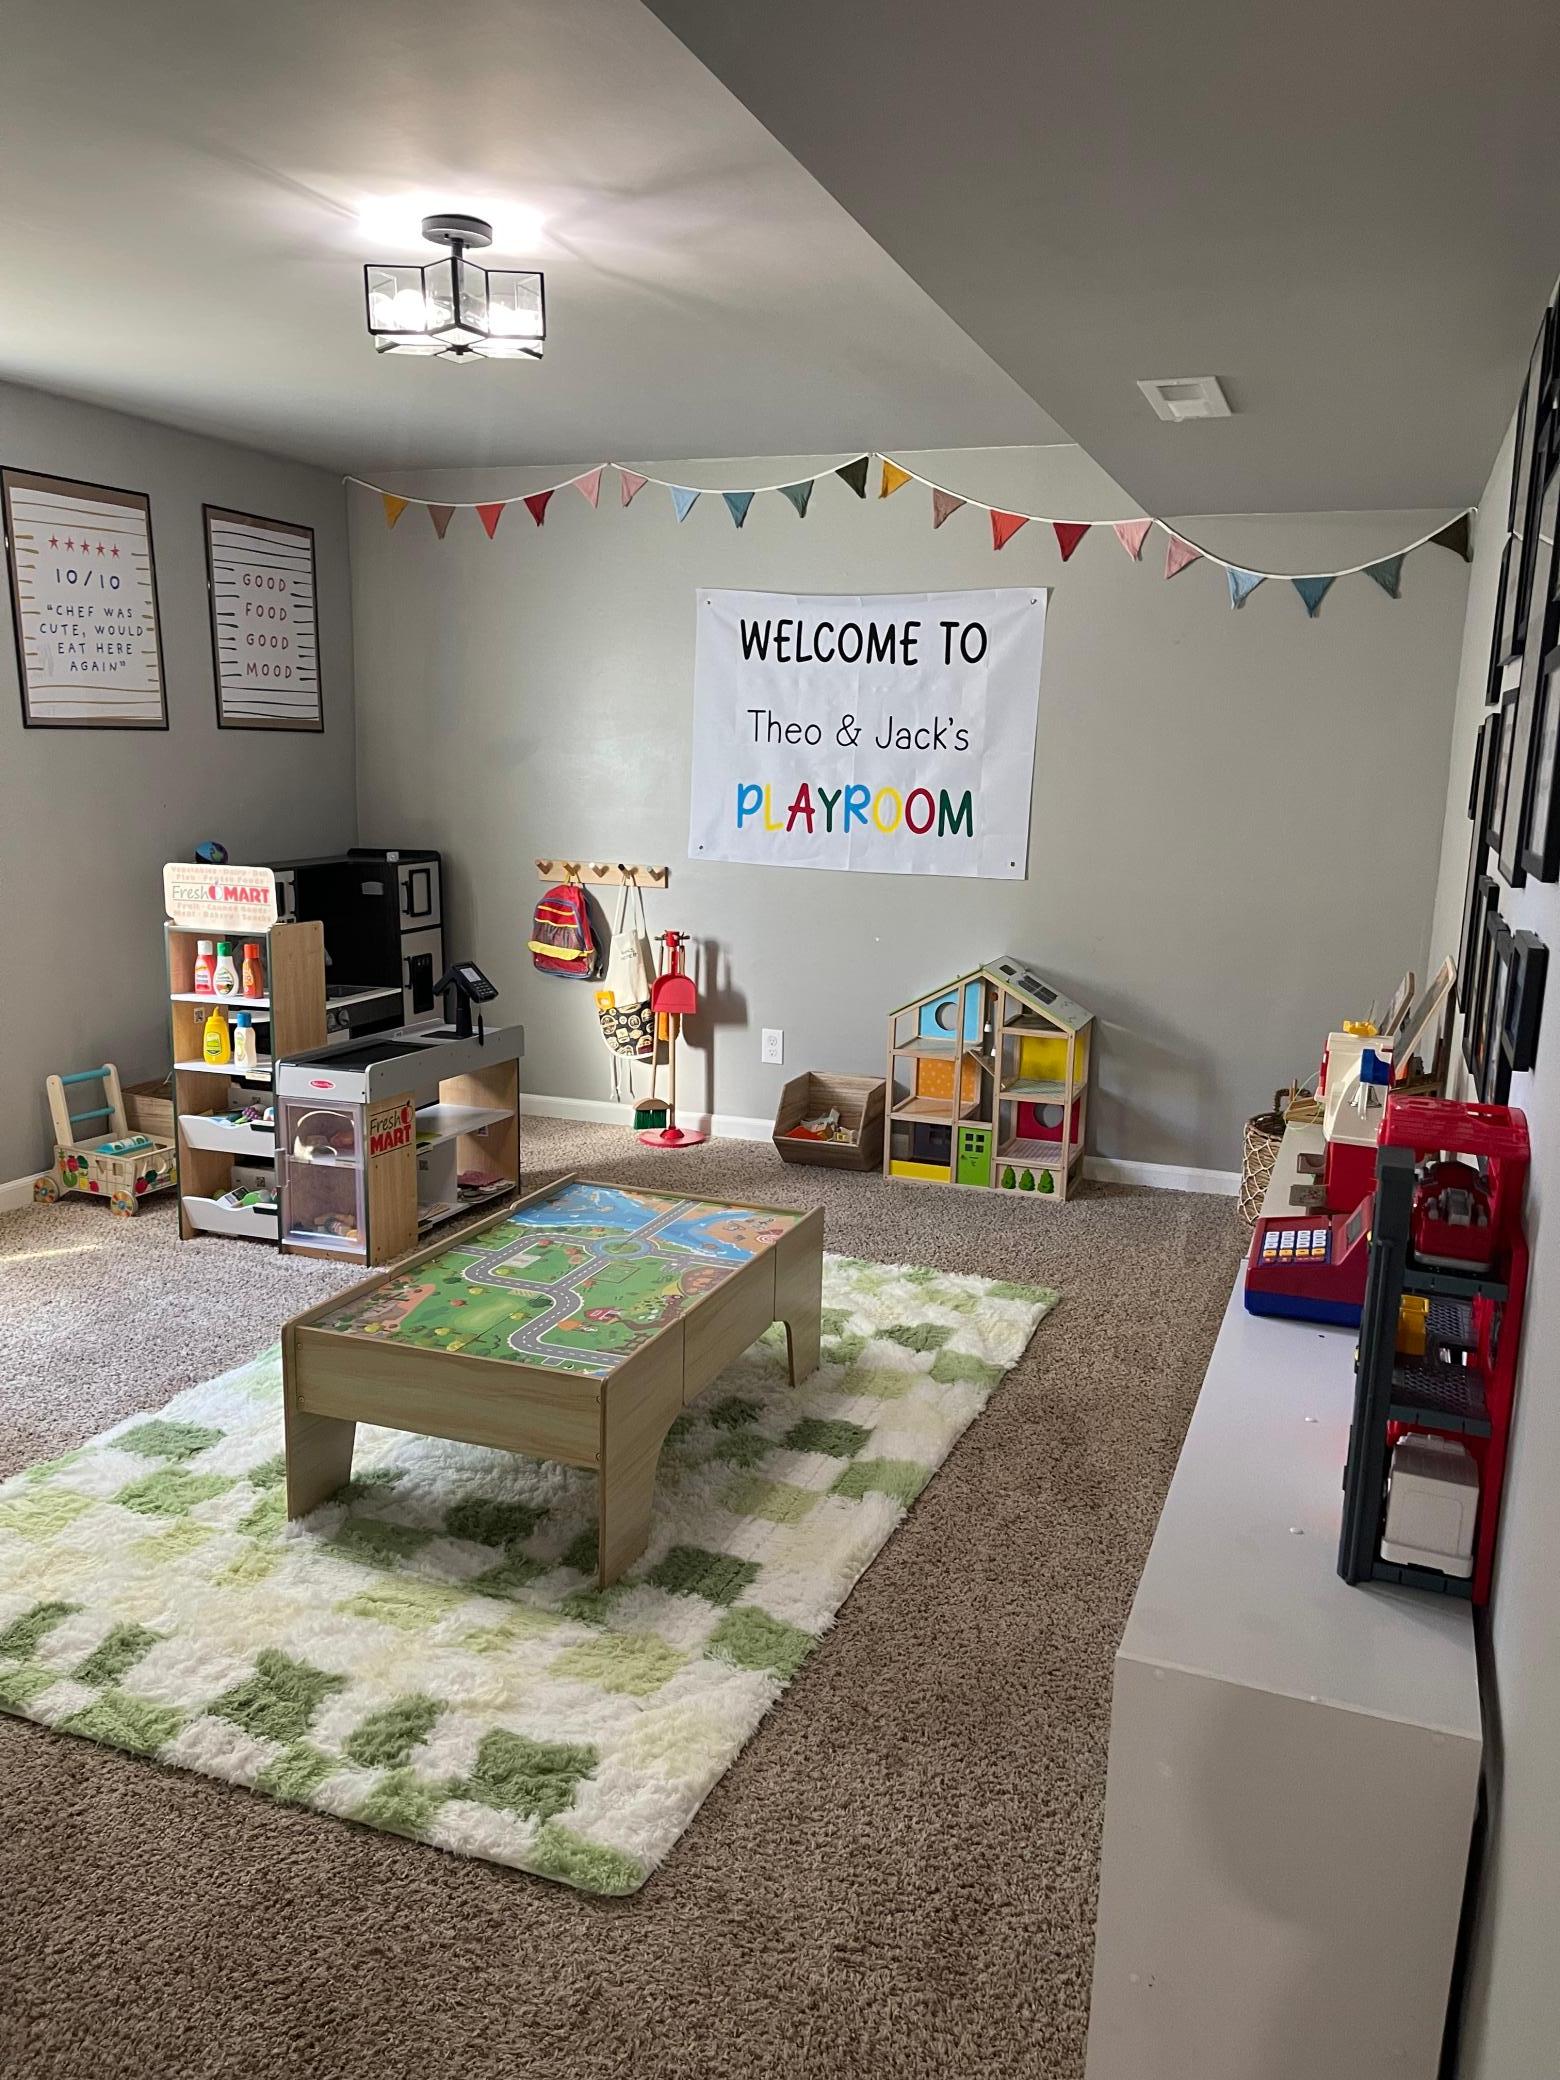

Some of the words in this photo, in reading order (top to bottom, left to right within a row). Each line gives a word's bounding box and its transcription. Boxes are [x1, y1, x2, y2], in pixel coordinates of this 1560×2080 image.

[56, 568, 121, 591] 10/10
[243, 573, 287, 592] GOOD
[47, 604, 94, 618] "CHEF
[104, 607, 133, 618] WAS
[245, 602, 287, 621] FOOD
[39, 623, 86, 638] CUTE,
[95, 625, 144, 636] WOULD
[58, 642, 86, 654] EAT
[96, 643, 133, 655] HERE
[246, 633, 289, 650] GOOD
[740, 618, 922, 666] WELCOME
[939, 621, 988, 666] TO
[70, 660, 126, 672] AGAIN"
[246, 662, 292, 679] MOOD
[747, 709, 822, 746] Theo
[836, 714, 862, 747] &
[875, 715, 970, 751] Jack's
[737, 782, 974, 838] PLAYROOM
[172, 885, 209, 900] Fresh
[224, 886, 270, 904] MART
[369, 1110, 402, 1136] Fresh
[369, 1124, 412, 1155] MART
